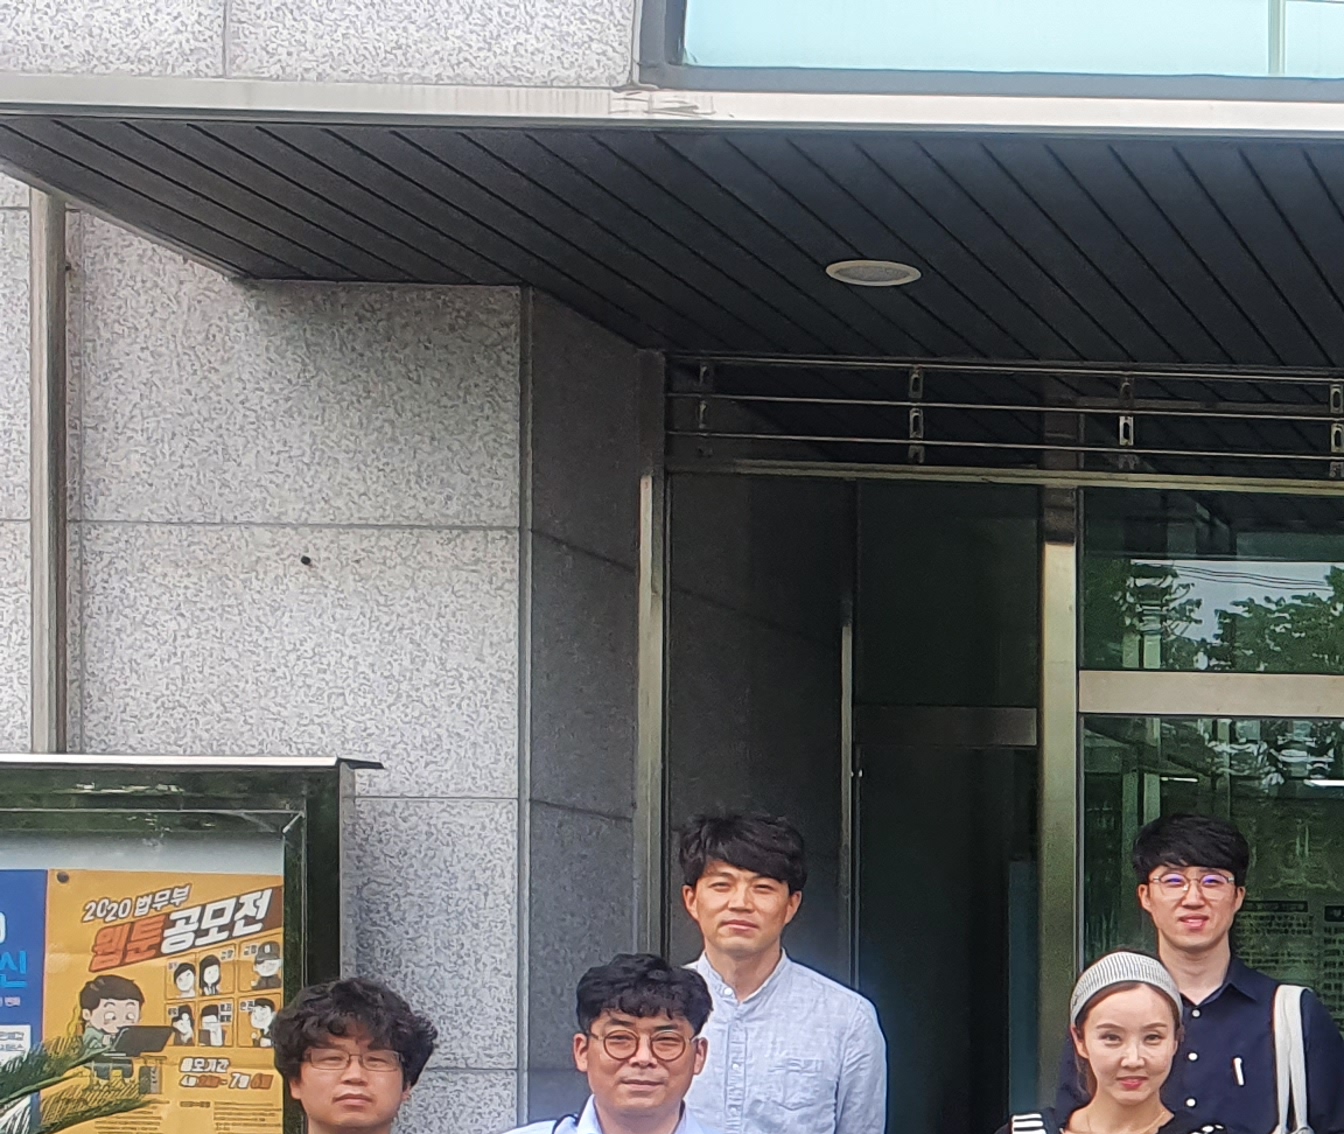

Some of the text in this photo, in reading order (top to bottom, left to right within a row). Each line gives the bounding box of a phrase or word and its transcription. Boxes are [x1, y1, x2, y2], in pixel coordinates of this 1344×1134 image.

[83, 885, 191, 922] 2020 법무부
[160, 889, 272, 954] 공모전
